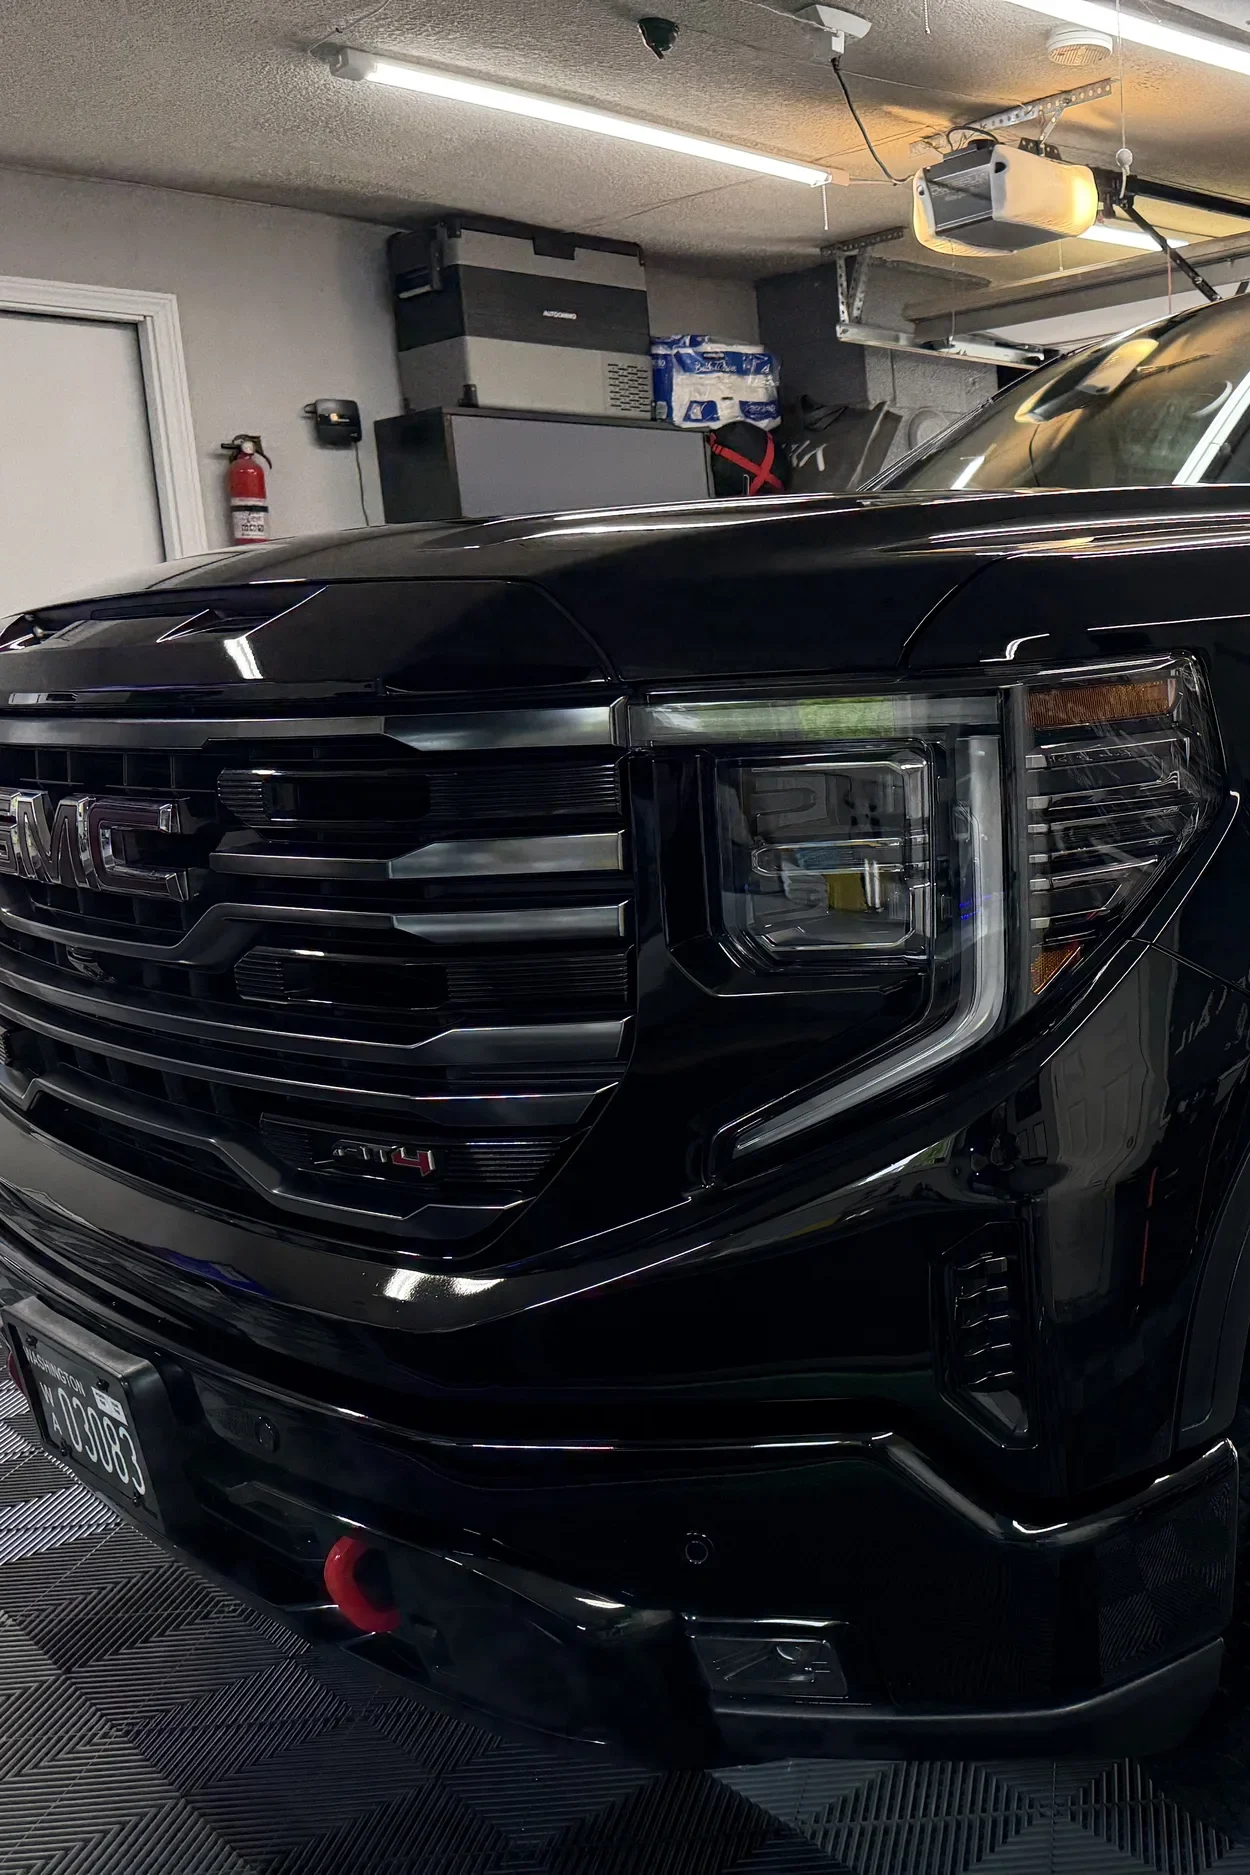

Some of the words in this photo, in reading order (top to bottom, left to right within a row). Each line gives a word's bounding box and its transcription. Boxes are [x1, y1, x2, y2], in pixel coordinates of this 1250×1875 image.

[331, 1139, 436, 1177] AT4
[23, 1346, 86, 1397] WASHINGTON
[57, 1387, 146, 1495] 03083
